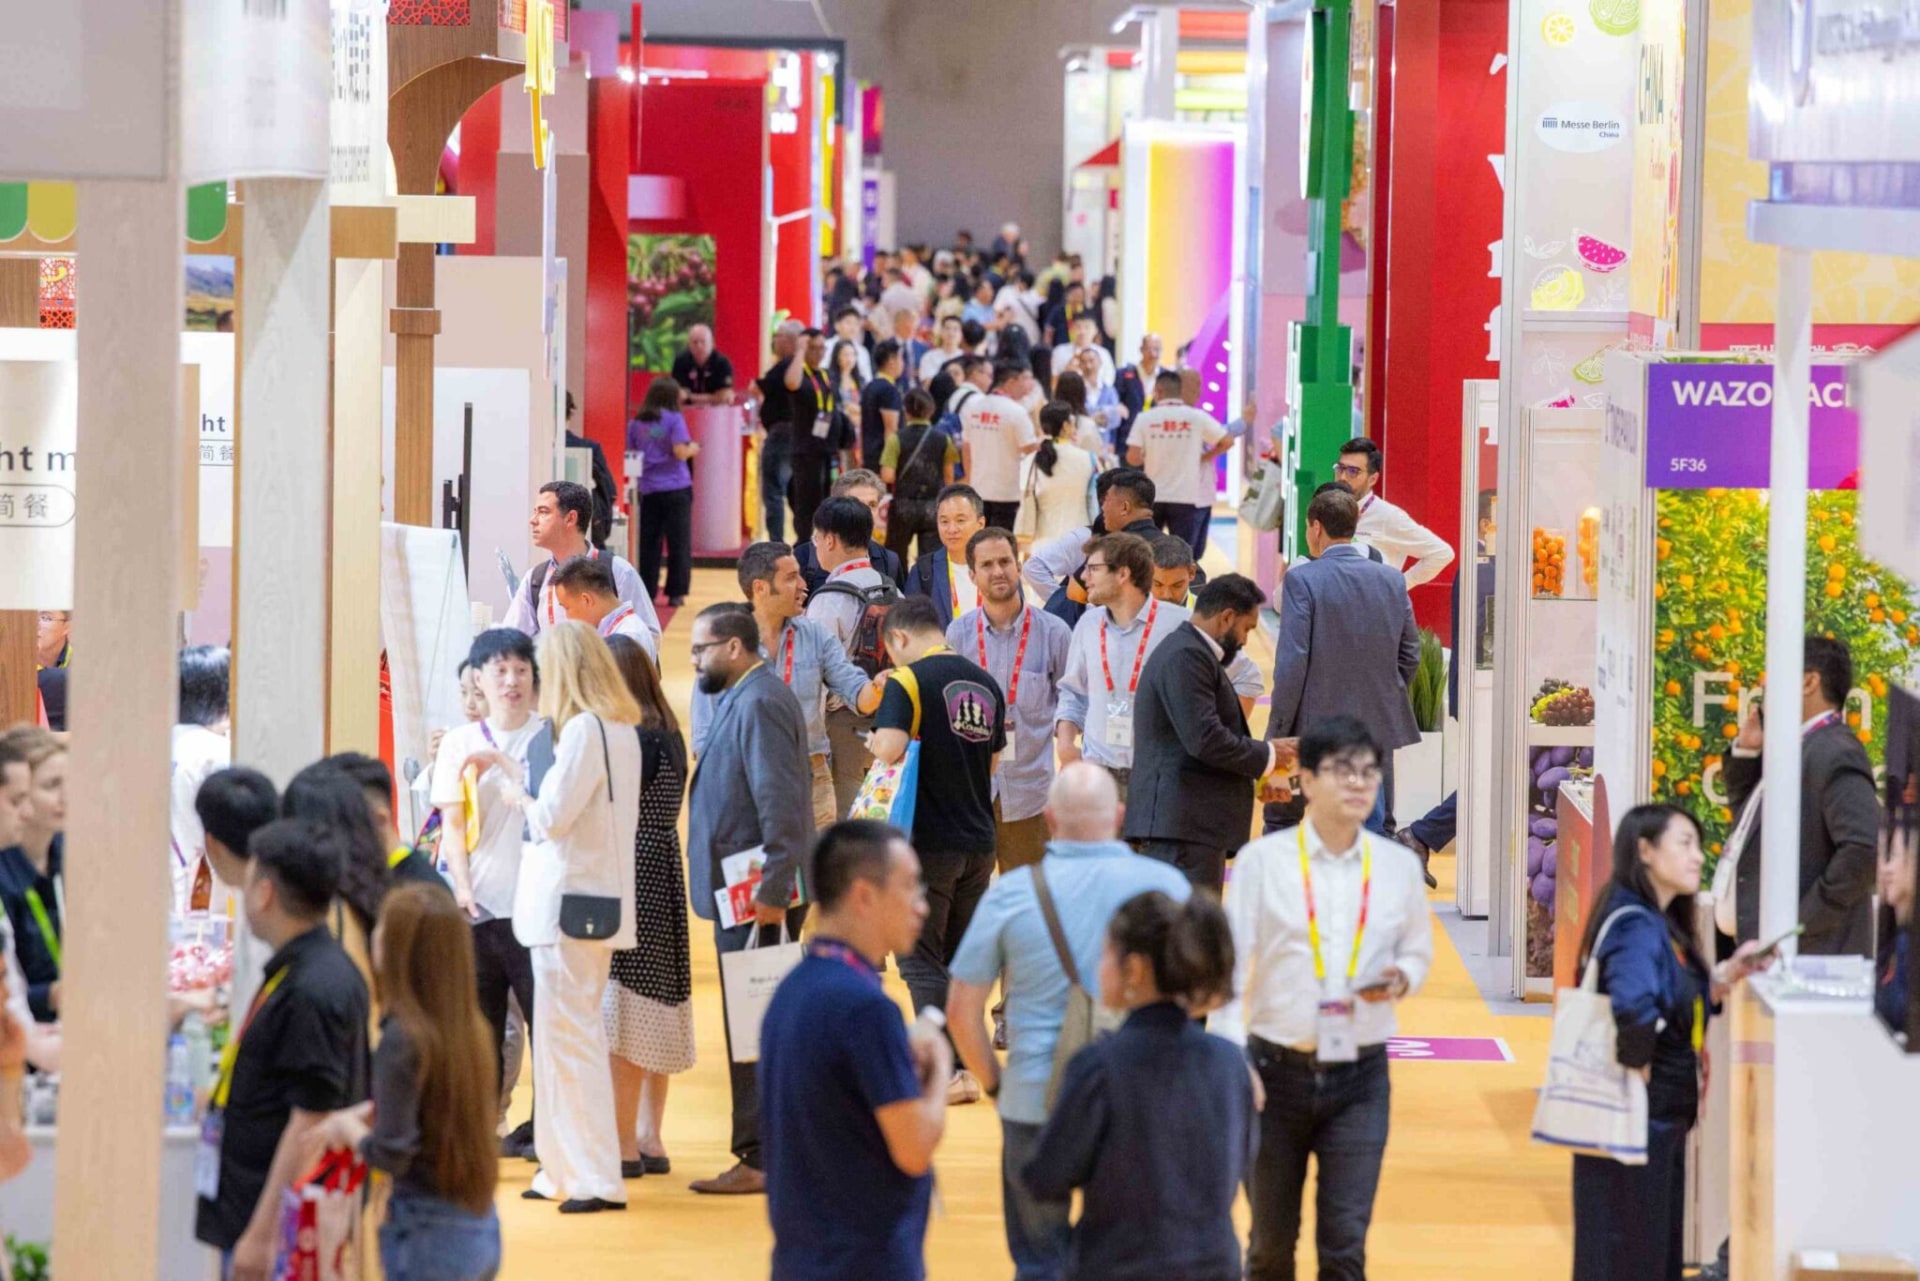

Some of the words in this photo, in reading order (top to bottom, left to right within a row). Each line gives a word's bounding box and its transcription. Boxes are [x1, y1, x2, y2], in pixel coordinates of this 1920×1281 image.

[1561, 120, 1590, 129] Messe
[1592, 119, 1620, 129] Berlin
[1670, 458, 1707, 472] 5F36
